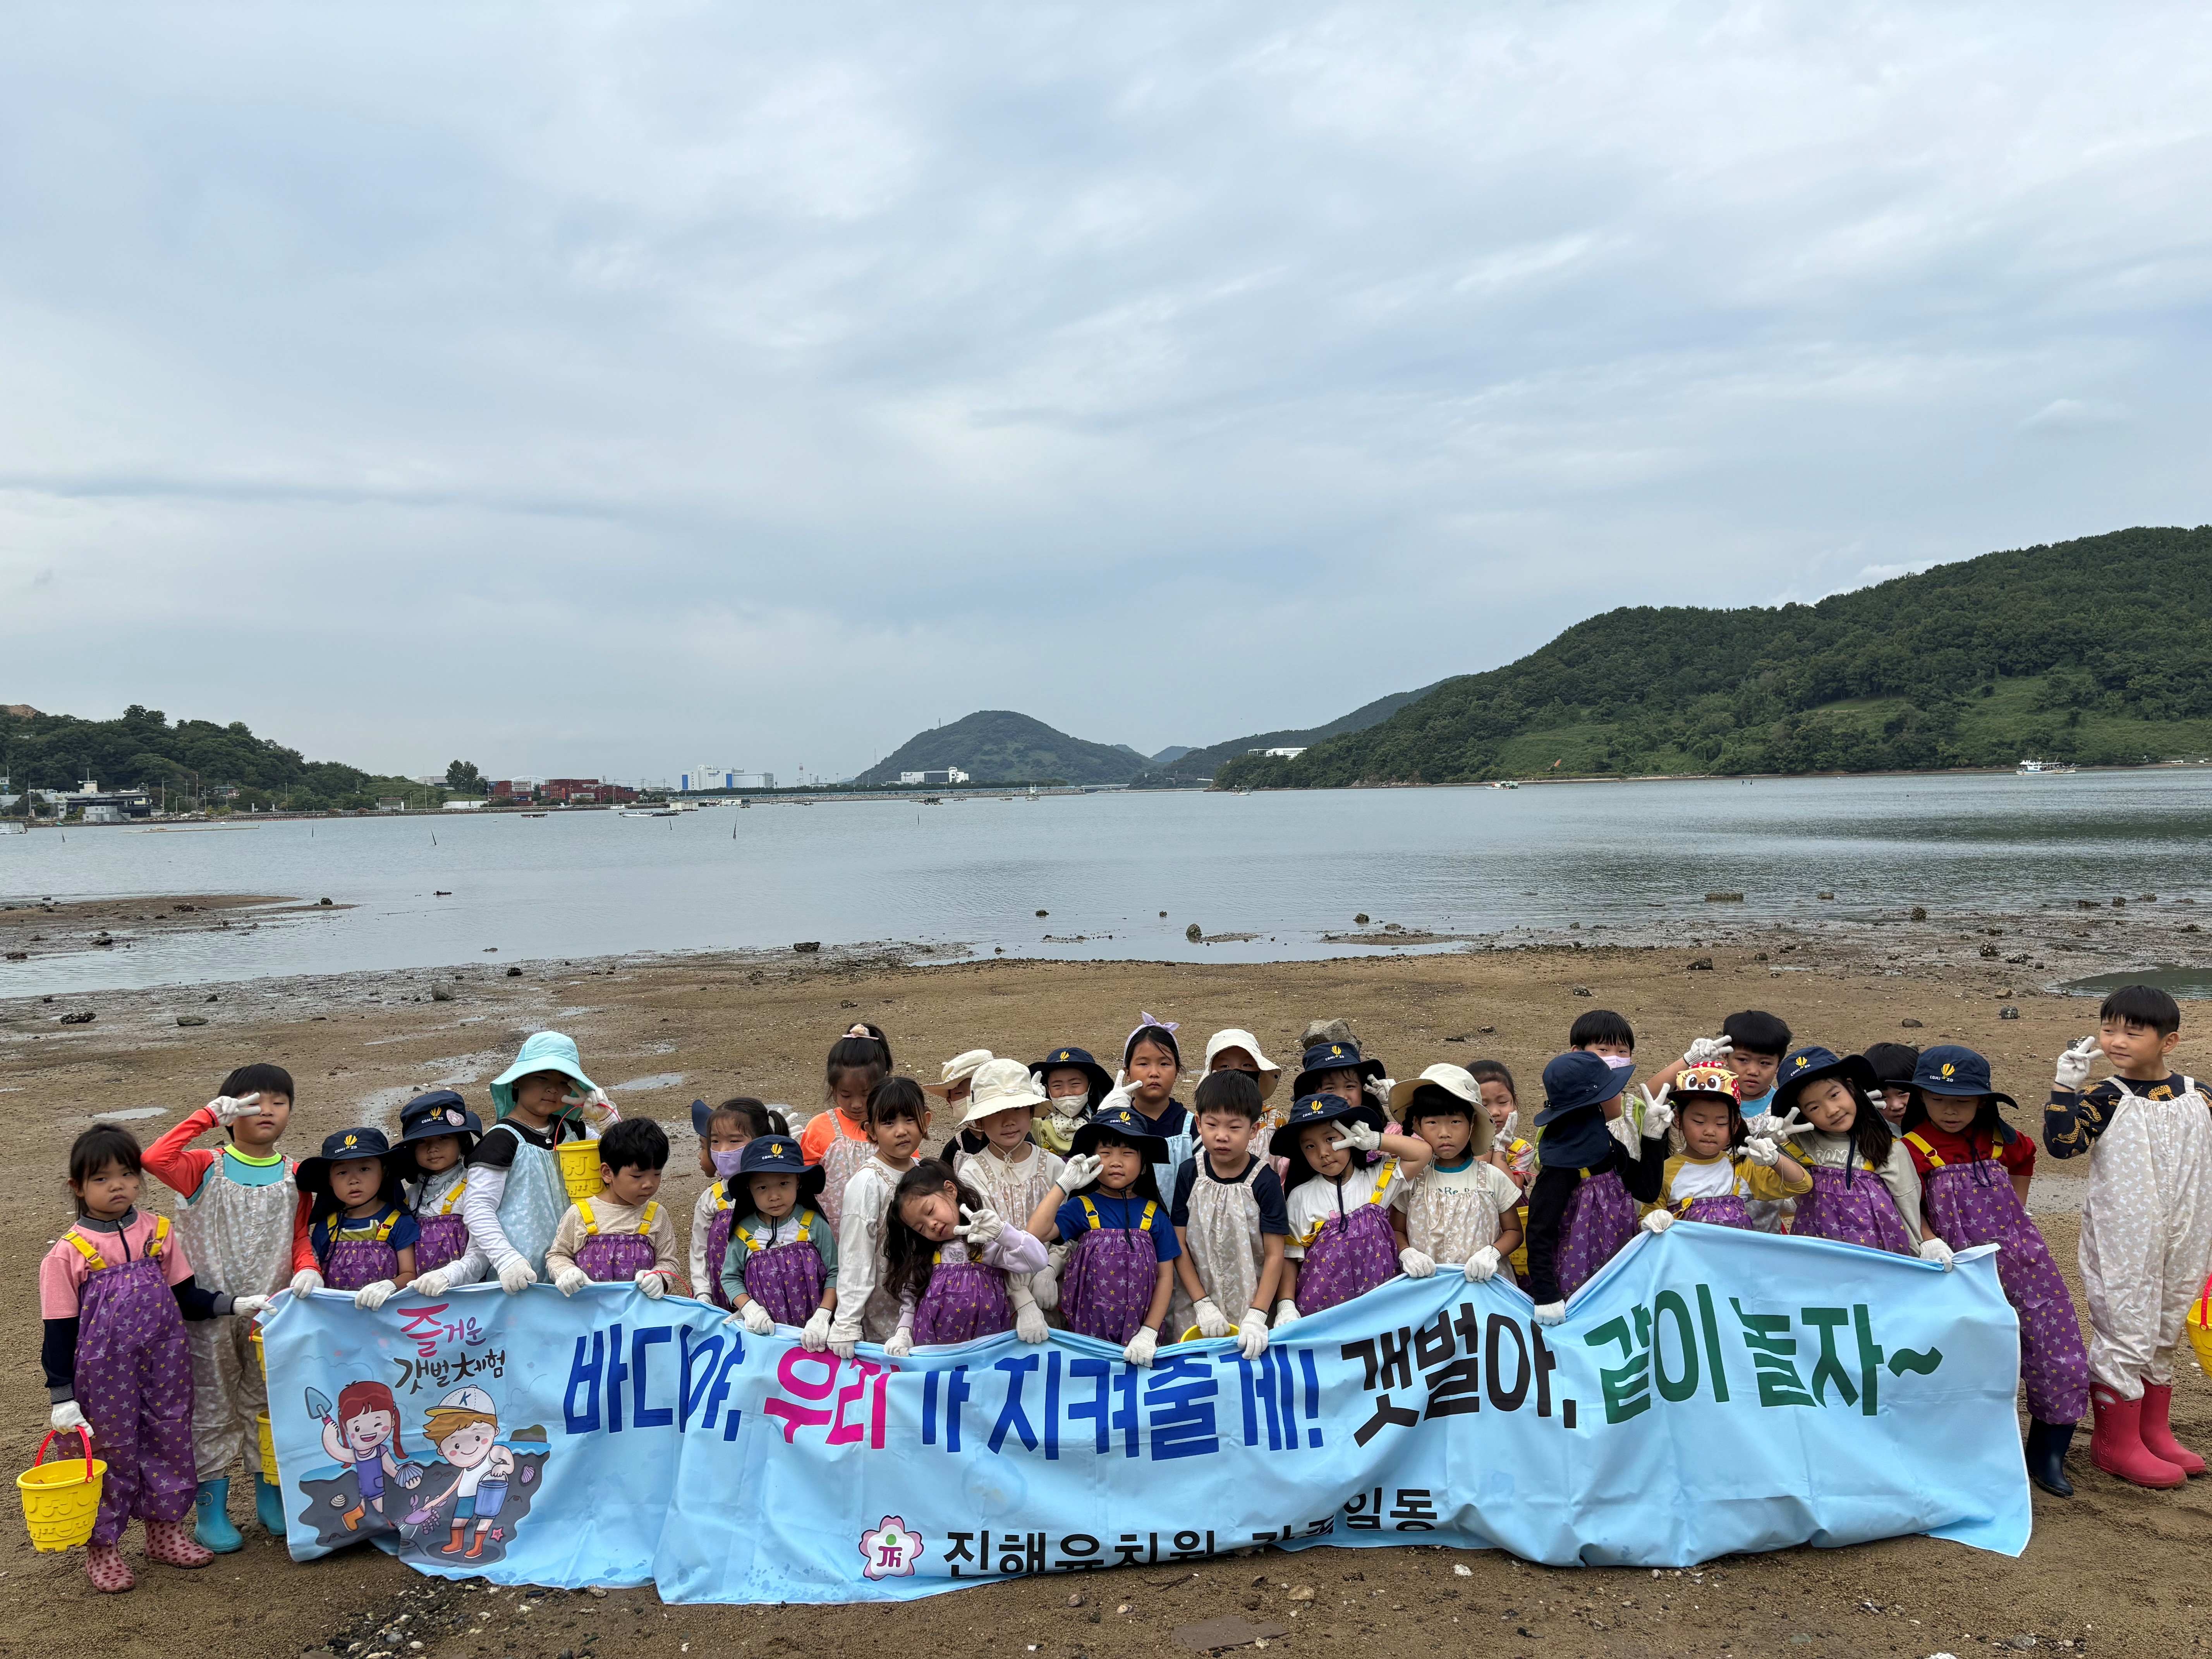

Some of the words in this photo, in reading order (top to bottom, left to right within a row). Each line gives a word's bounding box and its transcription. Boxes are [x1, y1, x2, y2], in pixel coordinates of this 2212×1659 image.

[397, 1303, 486, 1357] 즐거운
[393, 1348, 505, 1395] 갯벌체험
[563, 1323, 745, 1441] 바다야,
[987, 1344, 1324, 1461] 지켜줄게!
[1341, 1303, 1577, 1448] 갯벌아,
[1583, 1284, 1730, 1424] 같이
[1728, 1297, 1943, 1416] 놀자~
[459, 1391, 471, 1406] K
[943, 1530, 1214, 1577] 진해유치원
